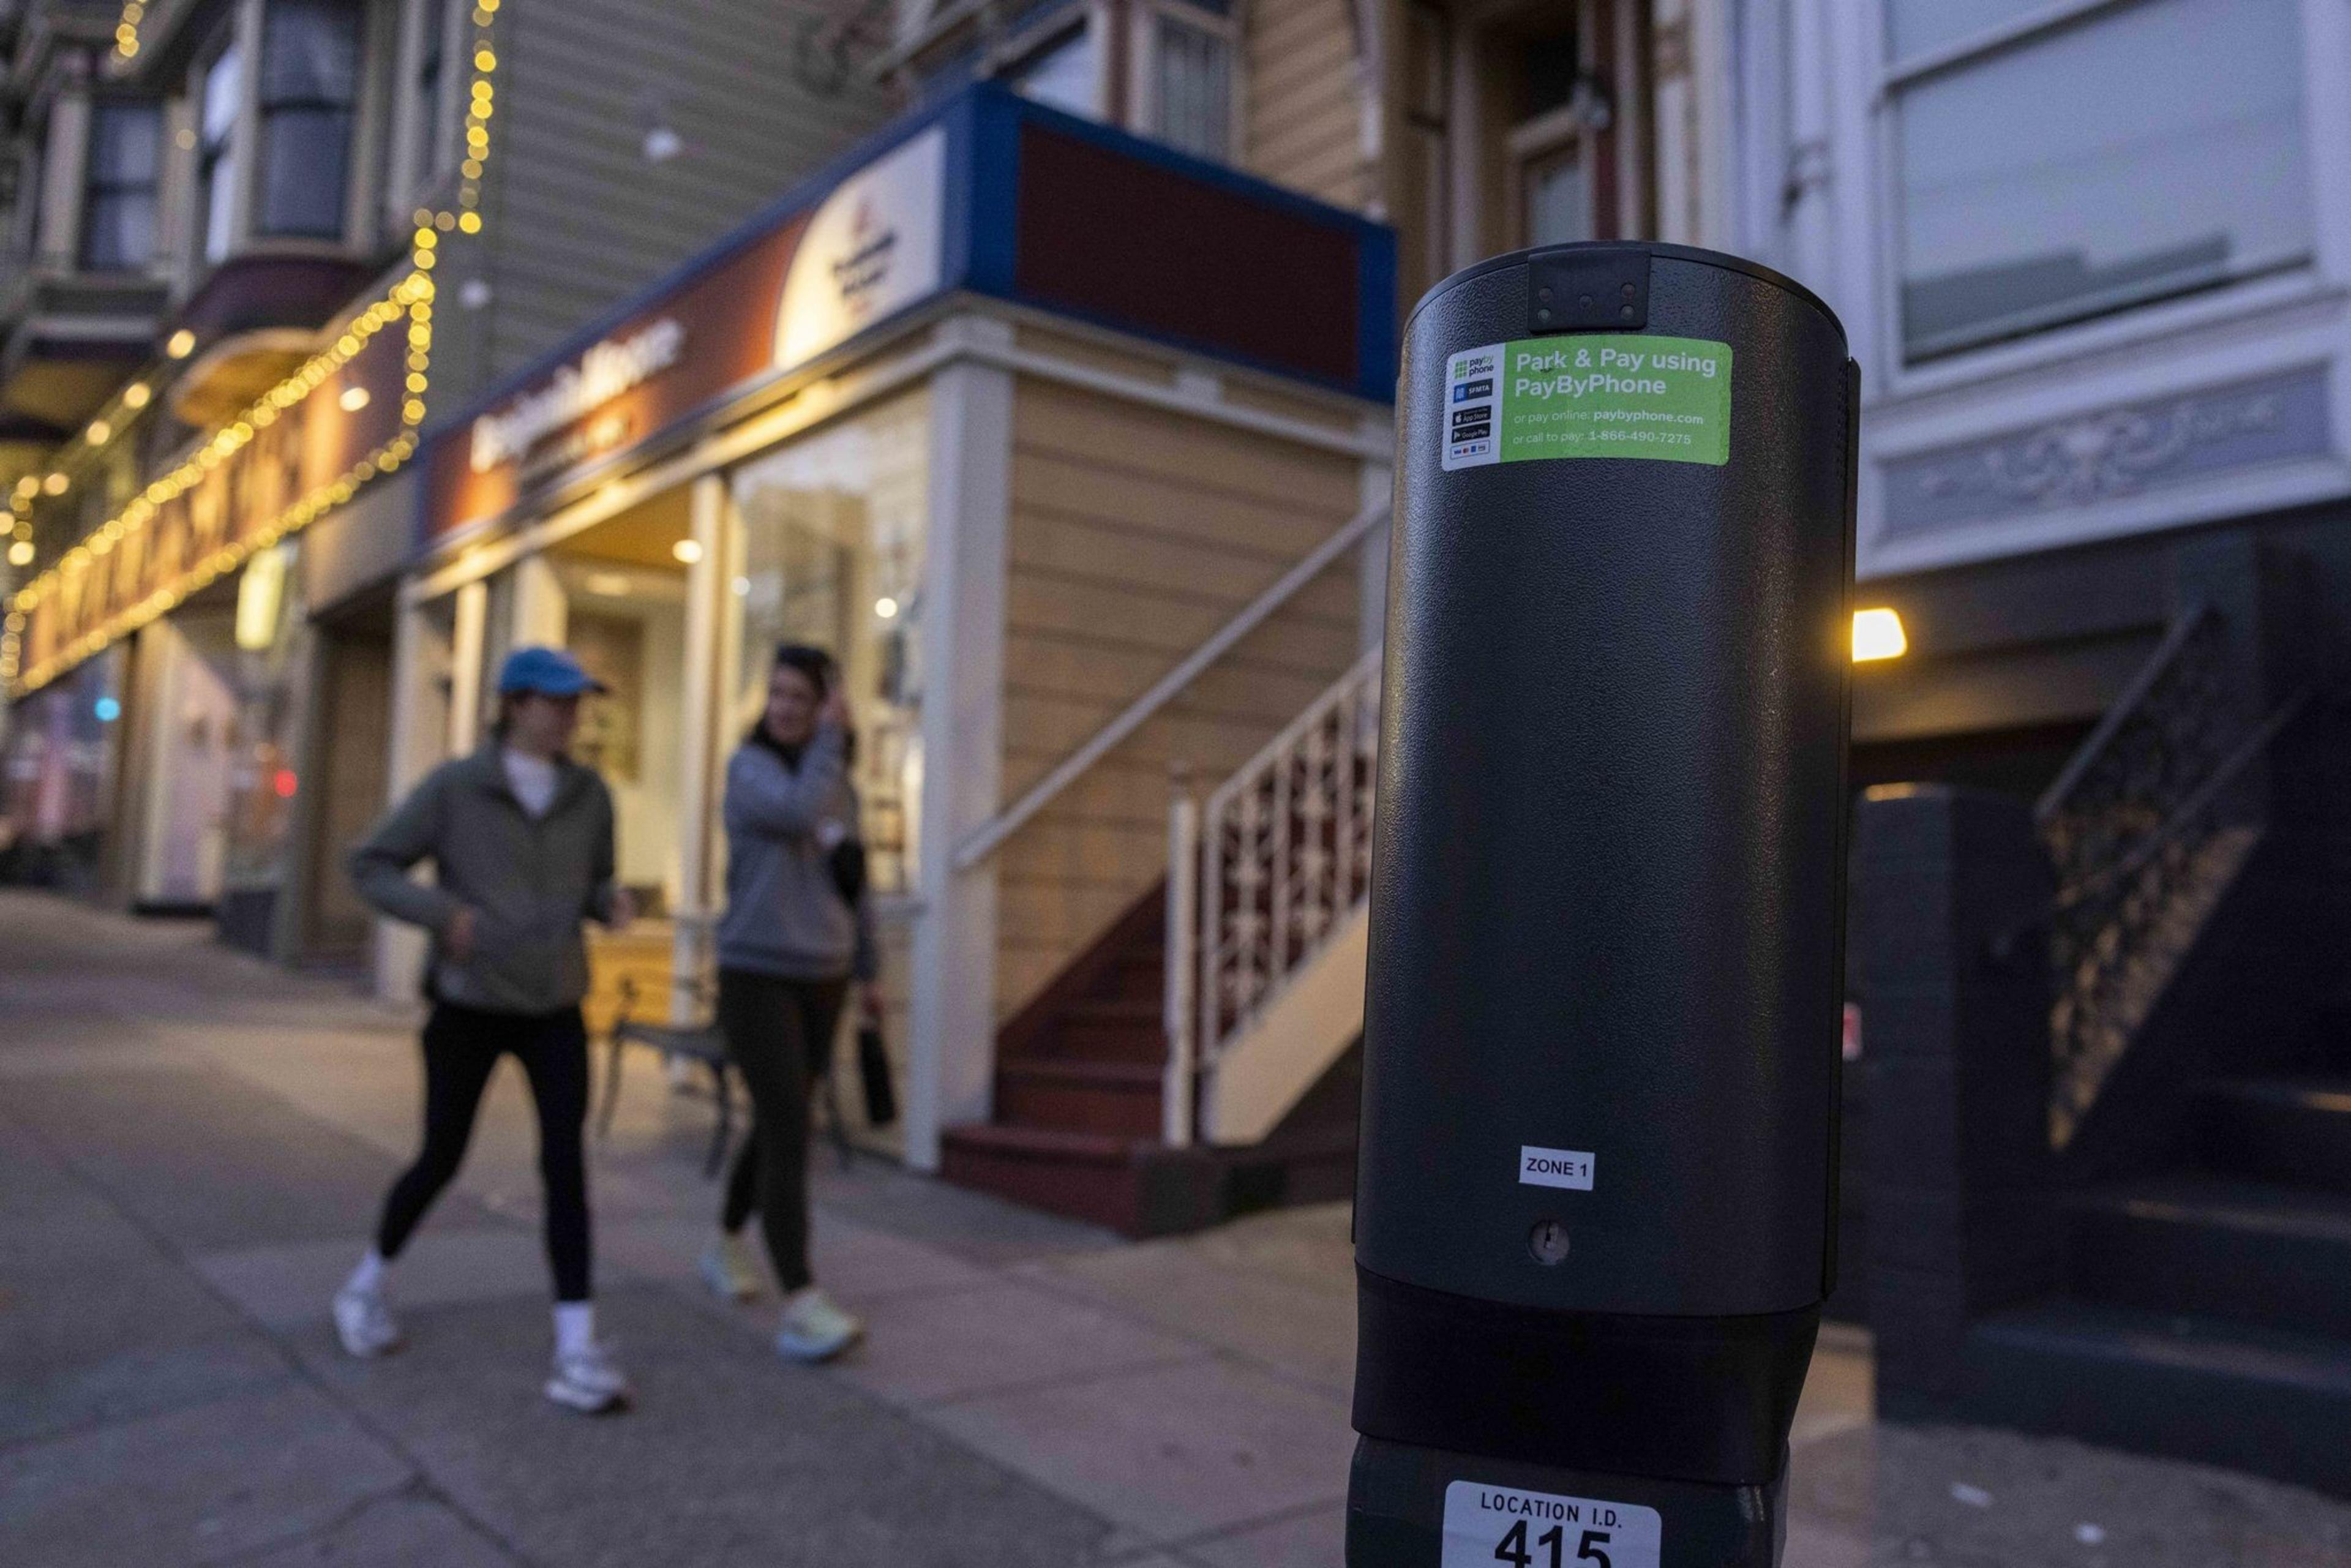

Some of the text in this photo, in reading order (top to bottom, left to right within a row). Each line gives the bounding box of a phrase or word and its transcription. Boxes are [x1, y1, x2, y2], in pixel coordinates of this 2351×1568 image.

[1469, 365, 1494, 377] phone
[1517, 348, 1715, 377] Park & Pay using
[1469, 384, 1490, 394] SFMTA
[1515, 374, 1666, 399] PayByPhone
[1514, 415, 1524, 424] or
[1528, 413, 1548, 424] pay
[1594, 409, 1703, 424] paybyphone.com
[1526, 432, 1543, 443] call
[1561, 433, 1584, 443] pay:
[1588, 431, 1691, 445] 1-866-490-7275
[1526, 1158, 1587, 1177] ZONE 1
[1481, 1492, 1622, 1528] LOCATION I.D.
[1494, 1519, 1611, 1568] 415
